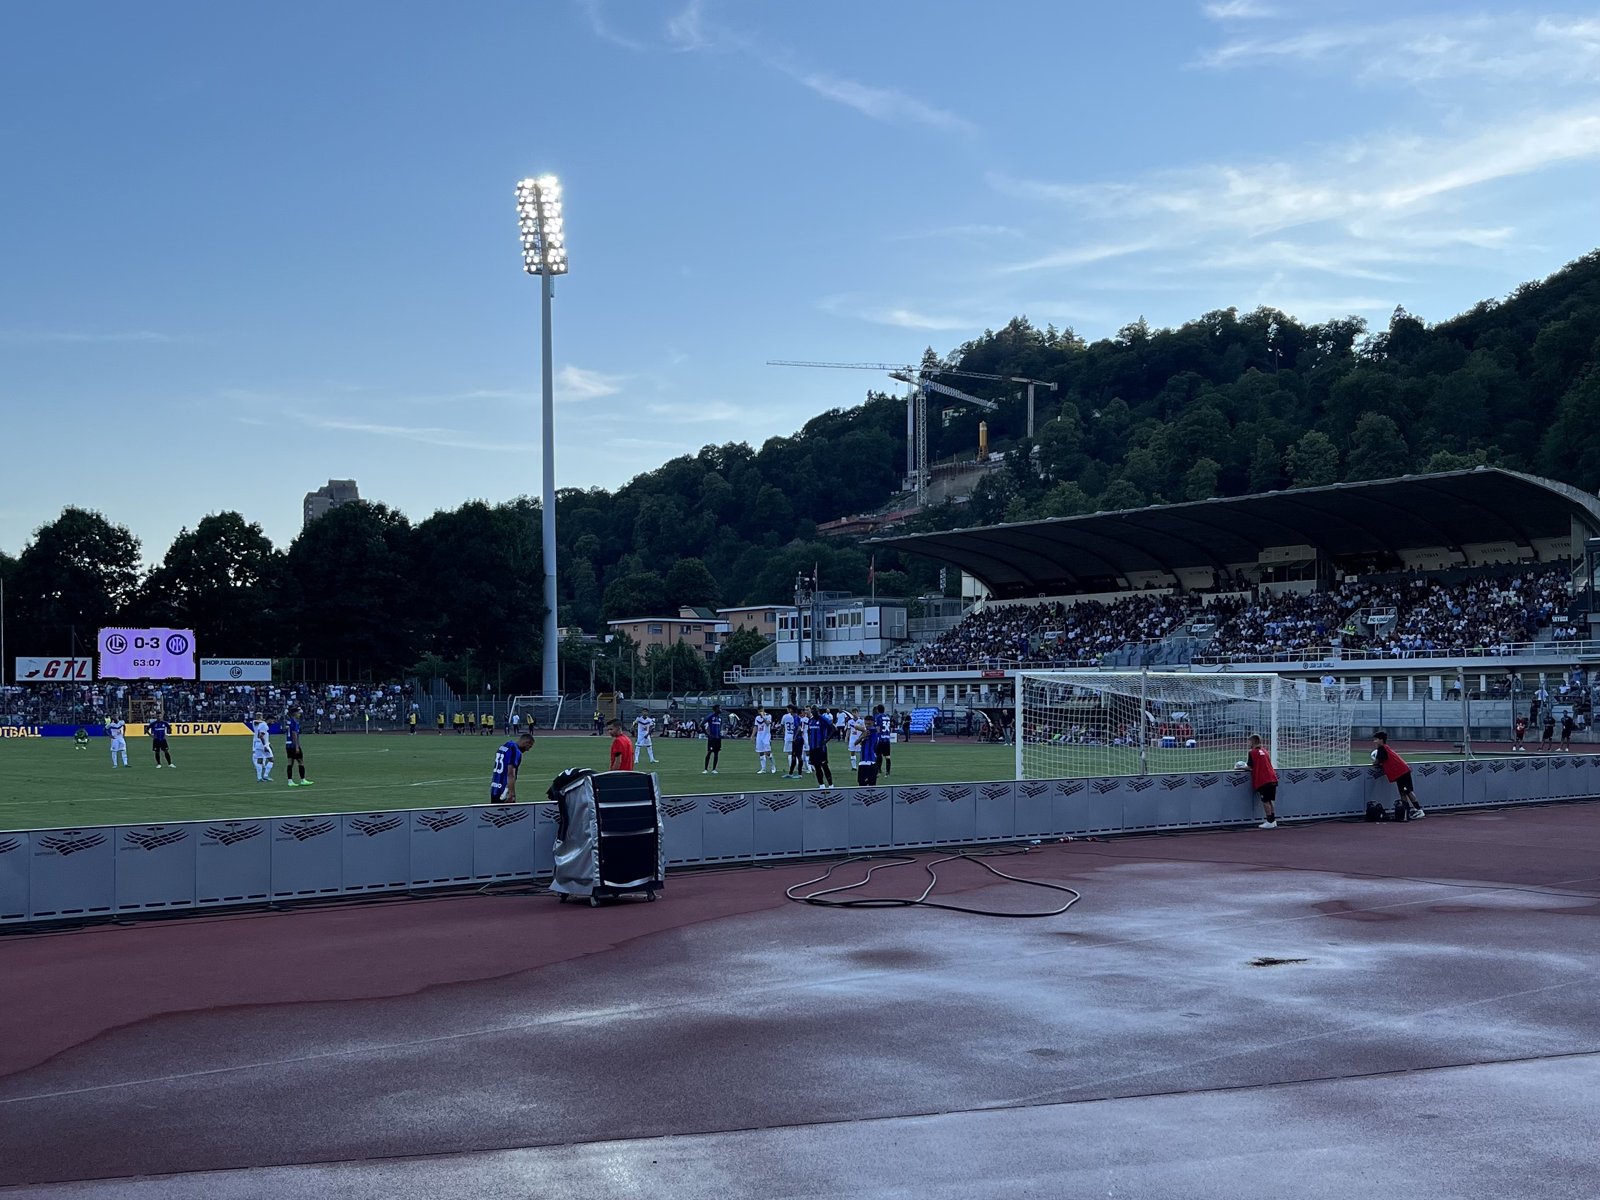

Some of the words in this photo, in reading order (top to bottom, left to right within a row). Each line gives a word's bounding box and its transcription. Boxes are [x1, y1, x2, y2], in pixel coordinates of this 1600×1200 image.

[134, 637, 160, 649] 0-3
[43, 659, 88, 678] GTL
[133, 659, 161, 667] 63:07
[0, 726, 42, 738] TBALL
[175, 724, 190, 734] TO
[193, 724, 222, 734] PLAY
[493, 752, 505, 774] 33
